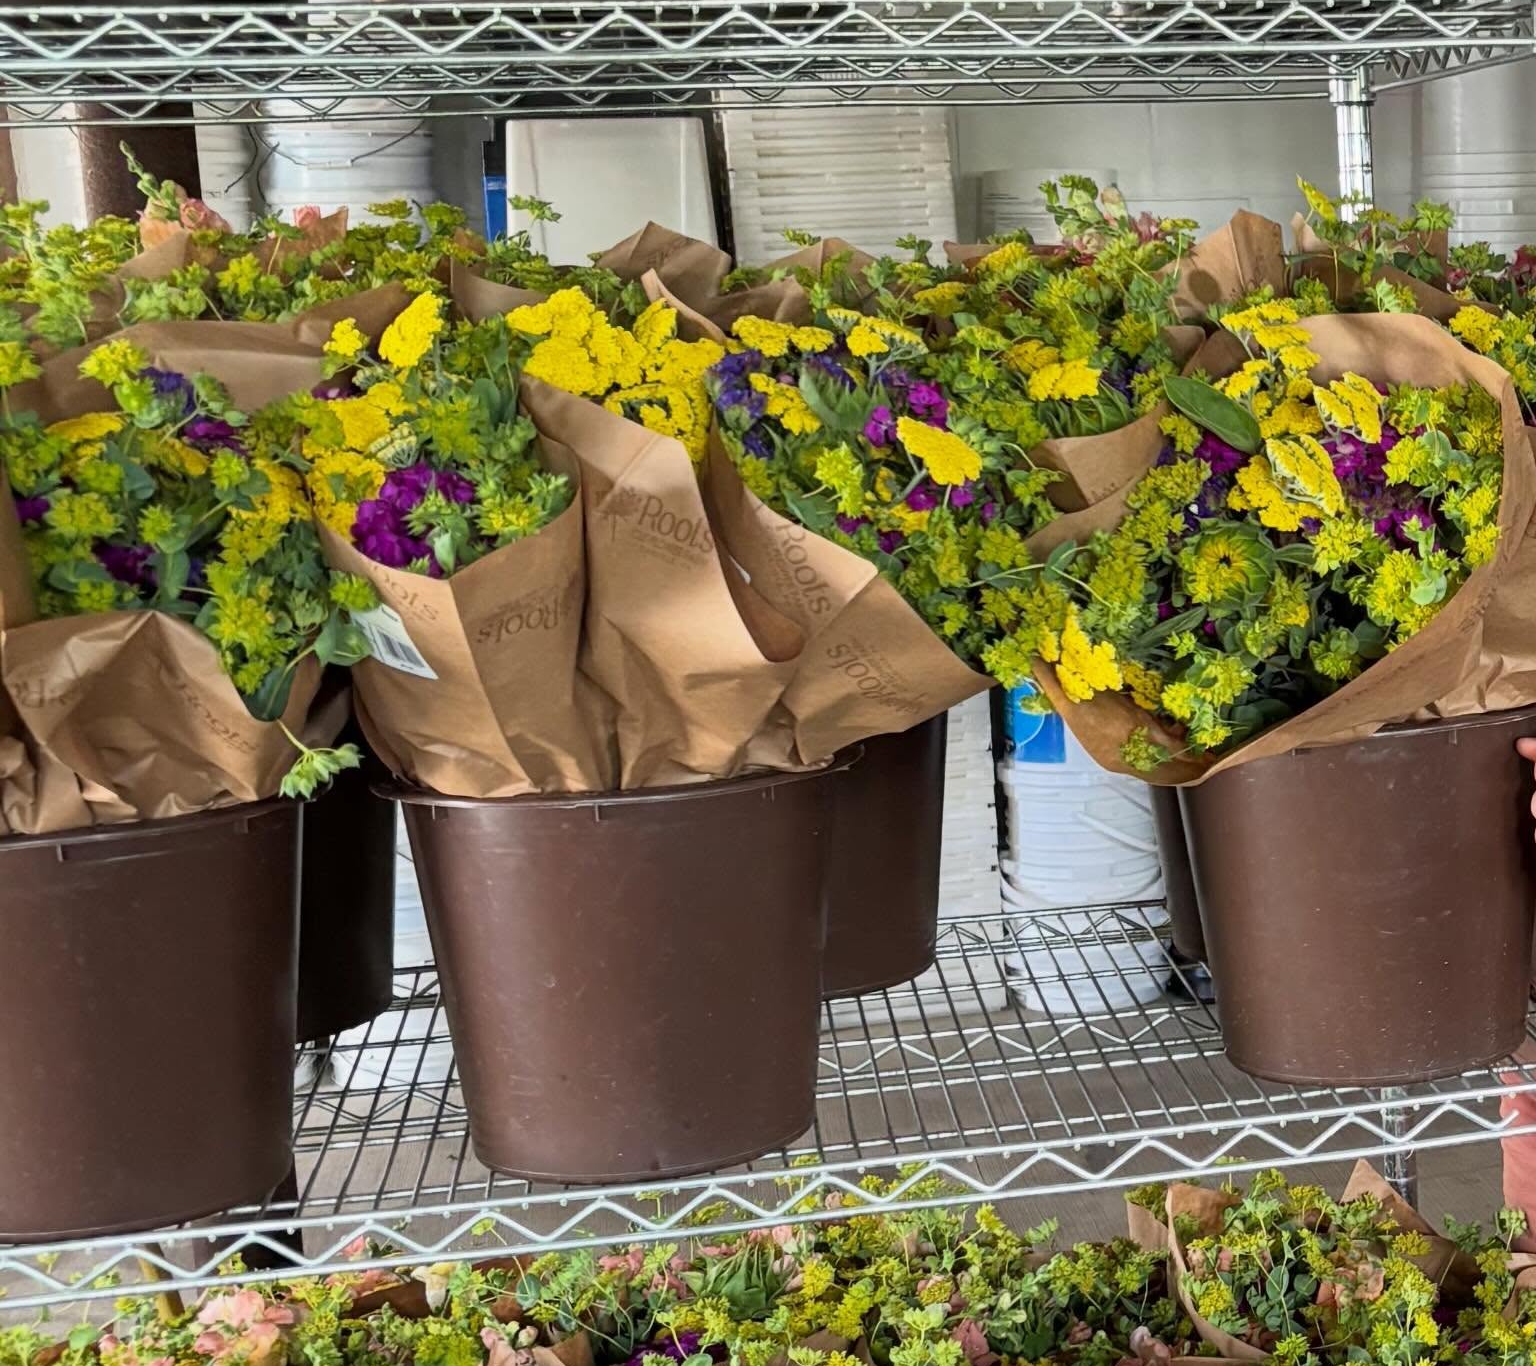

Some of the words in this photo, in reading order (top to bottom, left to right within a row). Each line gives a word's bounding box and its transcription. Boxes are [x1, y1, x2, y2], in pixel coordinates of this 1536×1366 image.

[638, 496, 714, 553] Roots
[776, 522, 832, 615] Roots
[476, 596, 558, 644] Roots
[826, 643, 891, 710] Roots
